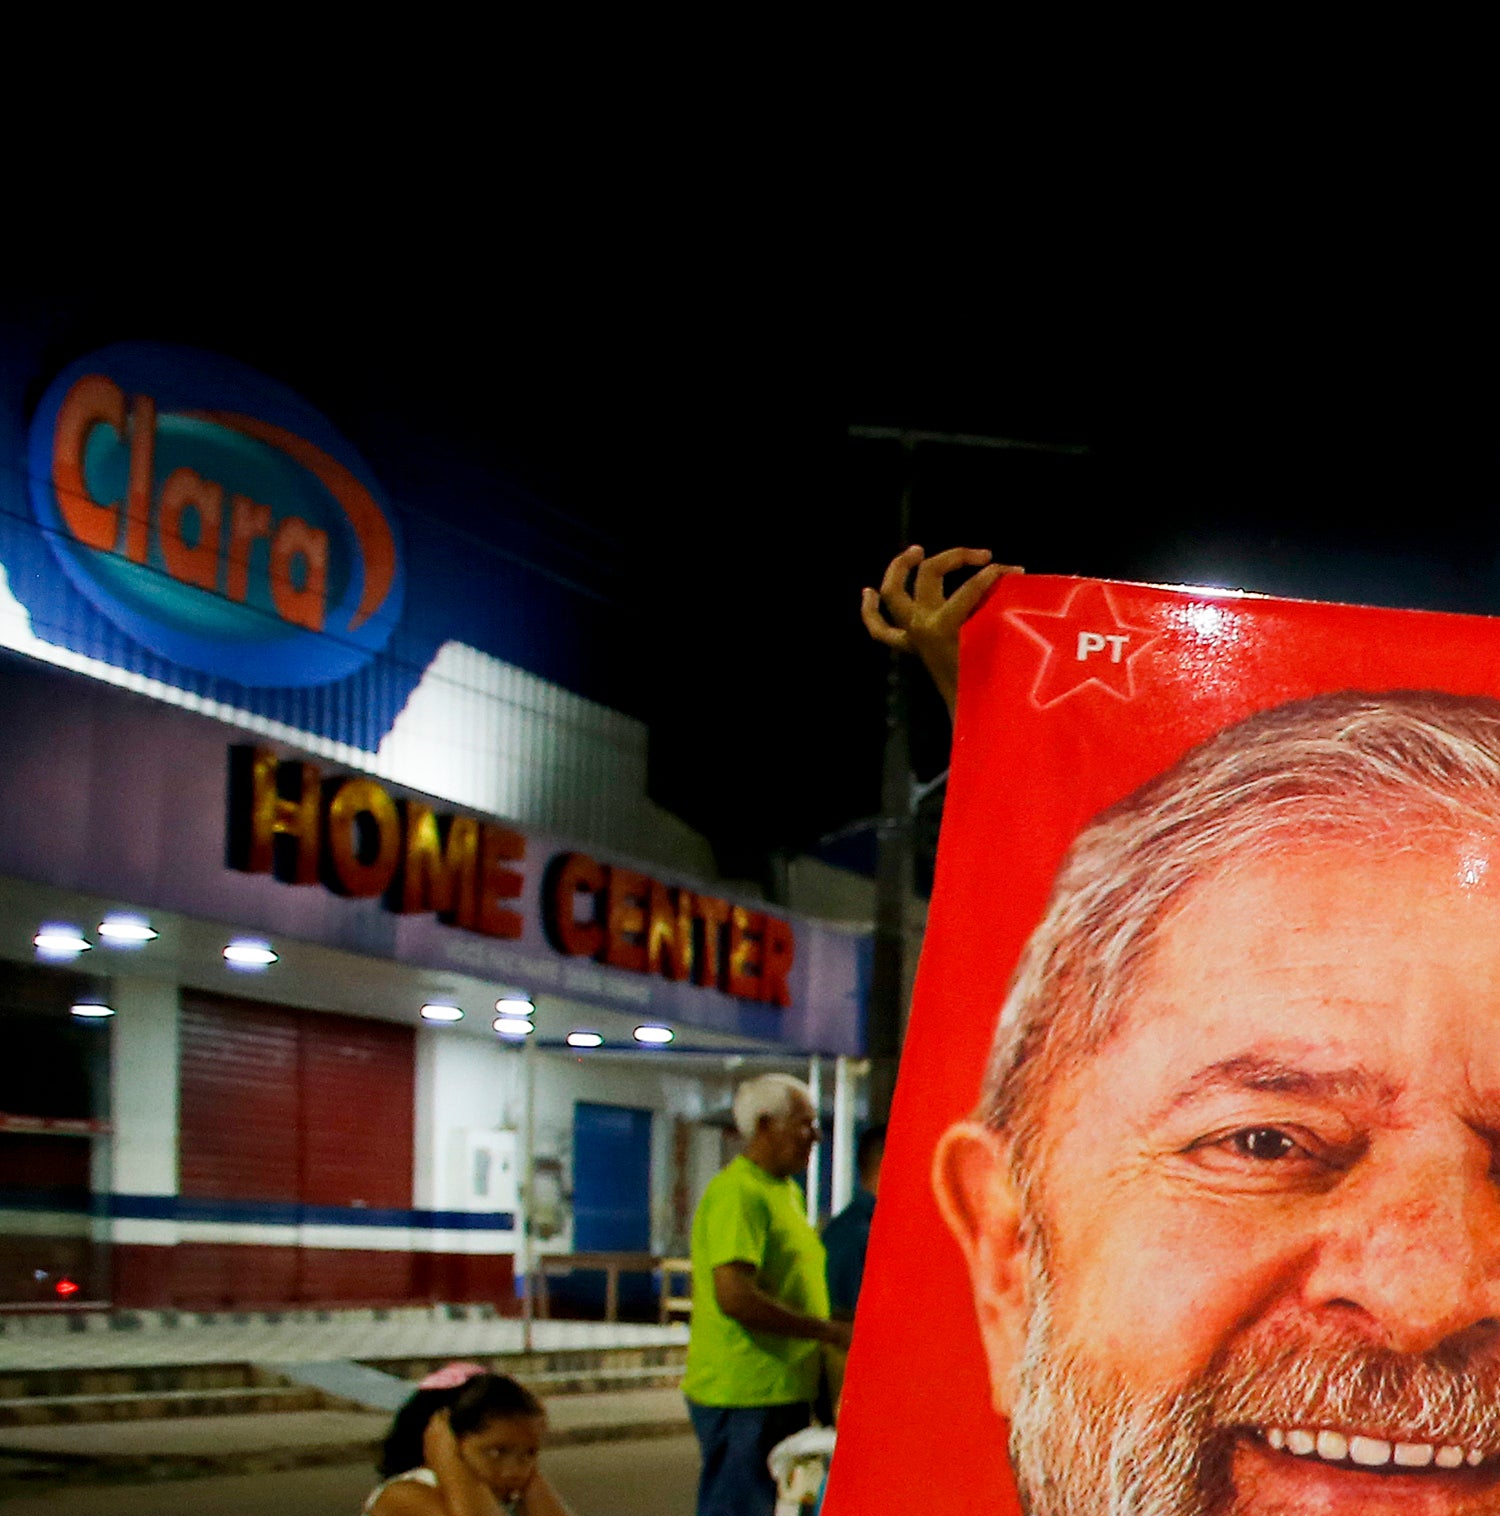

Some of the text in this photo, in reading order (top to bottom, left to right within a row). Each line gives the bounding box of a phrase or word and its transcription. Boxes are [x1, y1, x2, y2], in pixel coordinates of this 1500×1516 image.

[52, 373, 328, 632] Clara
[1077, 630, 1130, 663] PT
[227, 742, 795, 1006] HOME CENTER
